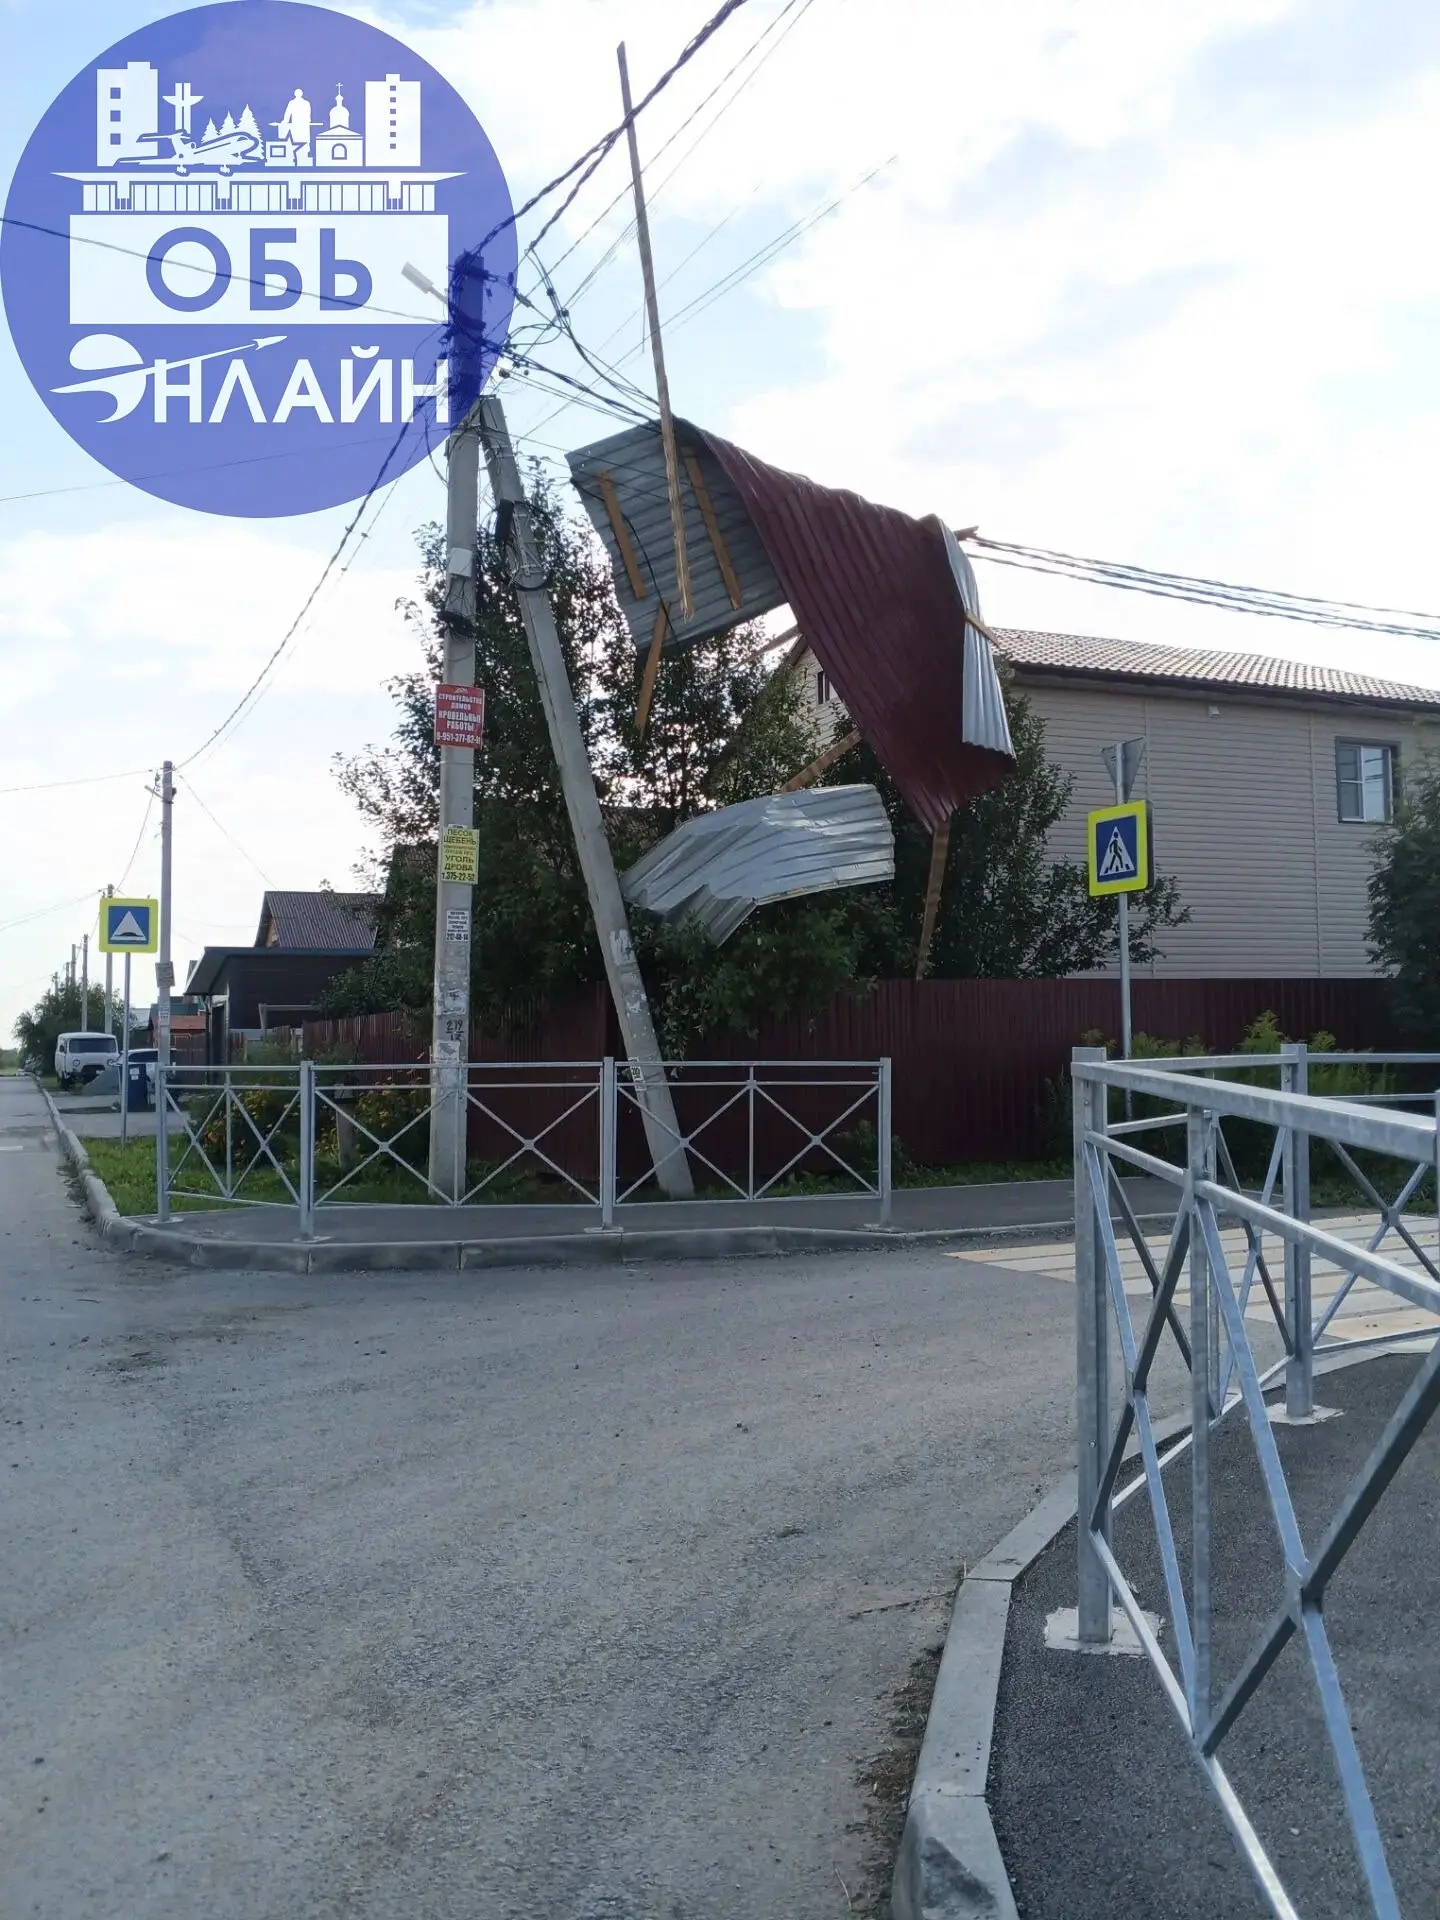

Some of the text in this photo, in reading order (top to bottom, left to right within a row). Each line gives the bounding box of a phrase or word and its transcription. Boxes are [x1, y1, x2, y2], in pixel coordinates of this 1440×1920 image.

[447, 721, 474, 731] РАБОТЫ
[444, 836, 477, 845] ЩЕБЕНЬ
[445, 855, 474, 864] УГОЛЬ
[444, 863, 473, 871] ДРОВА
